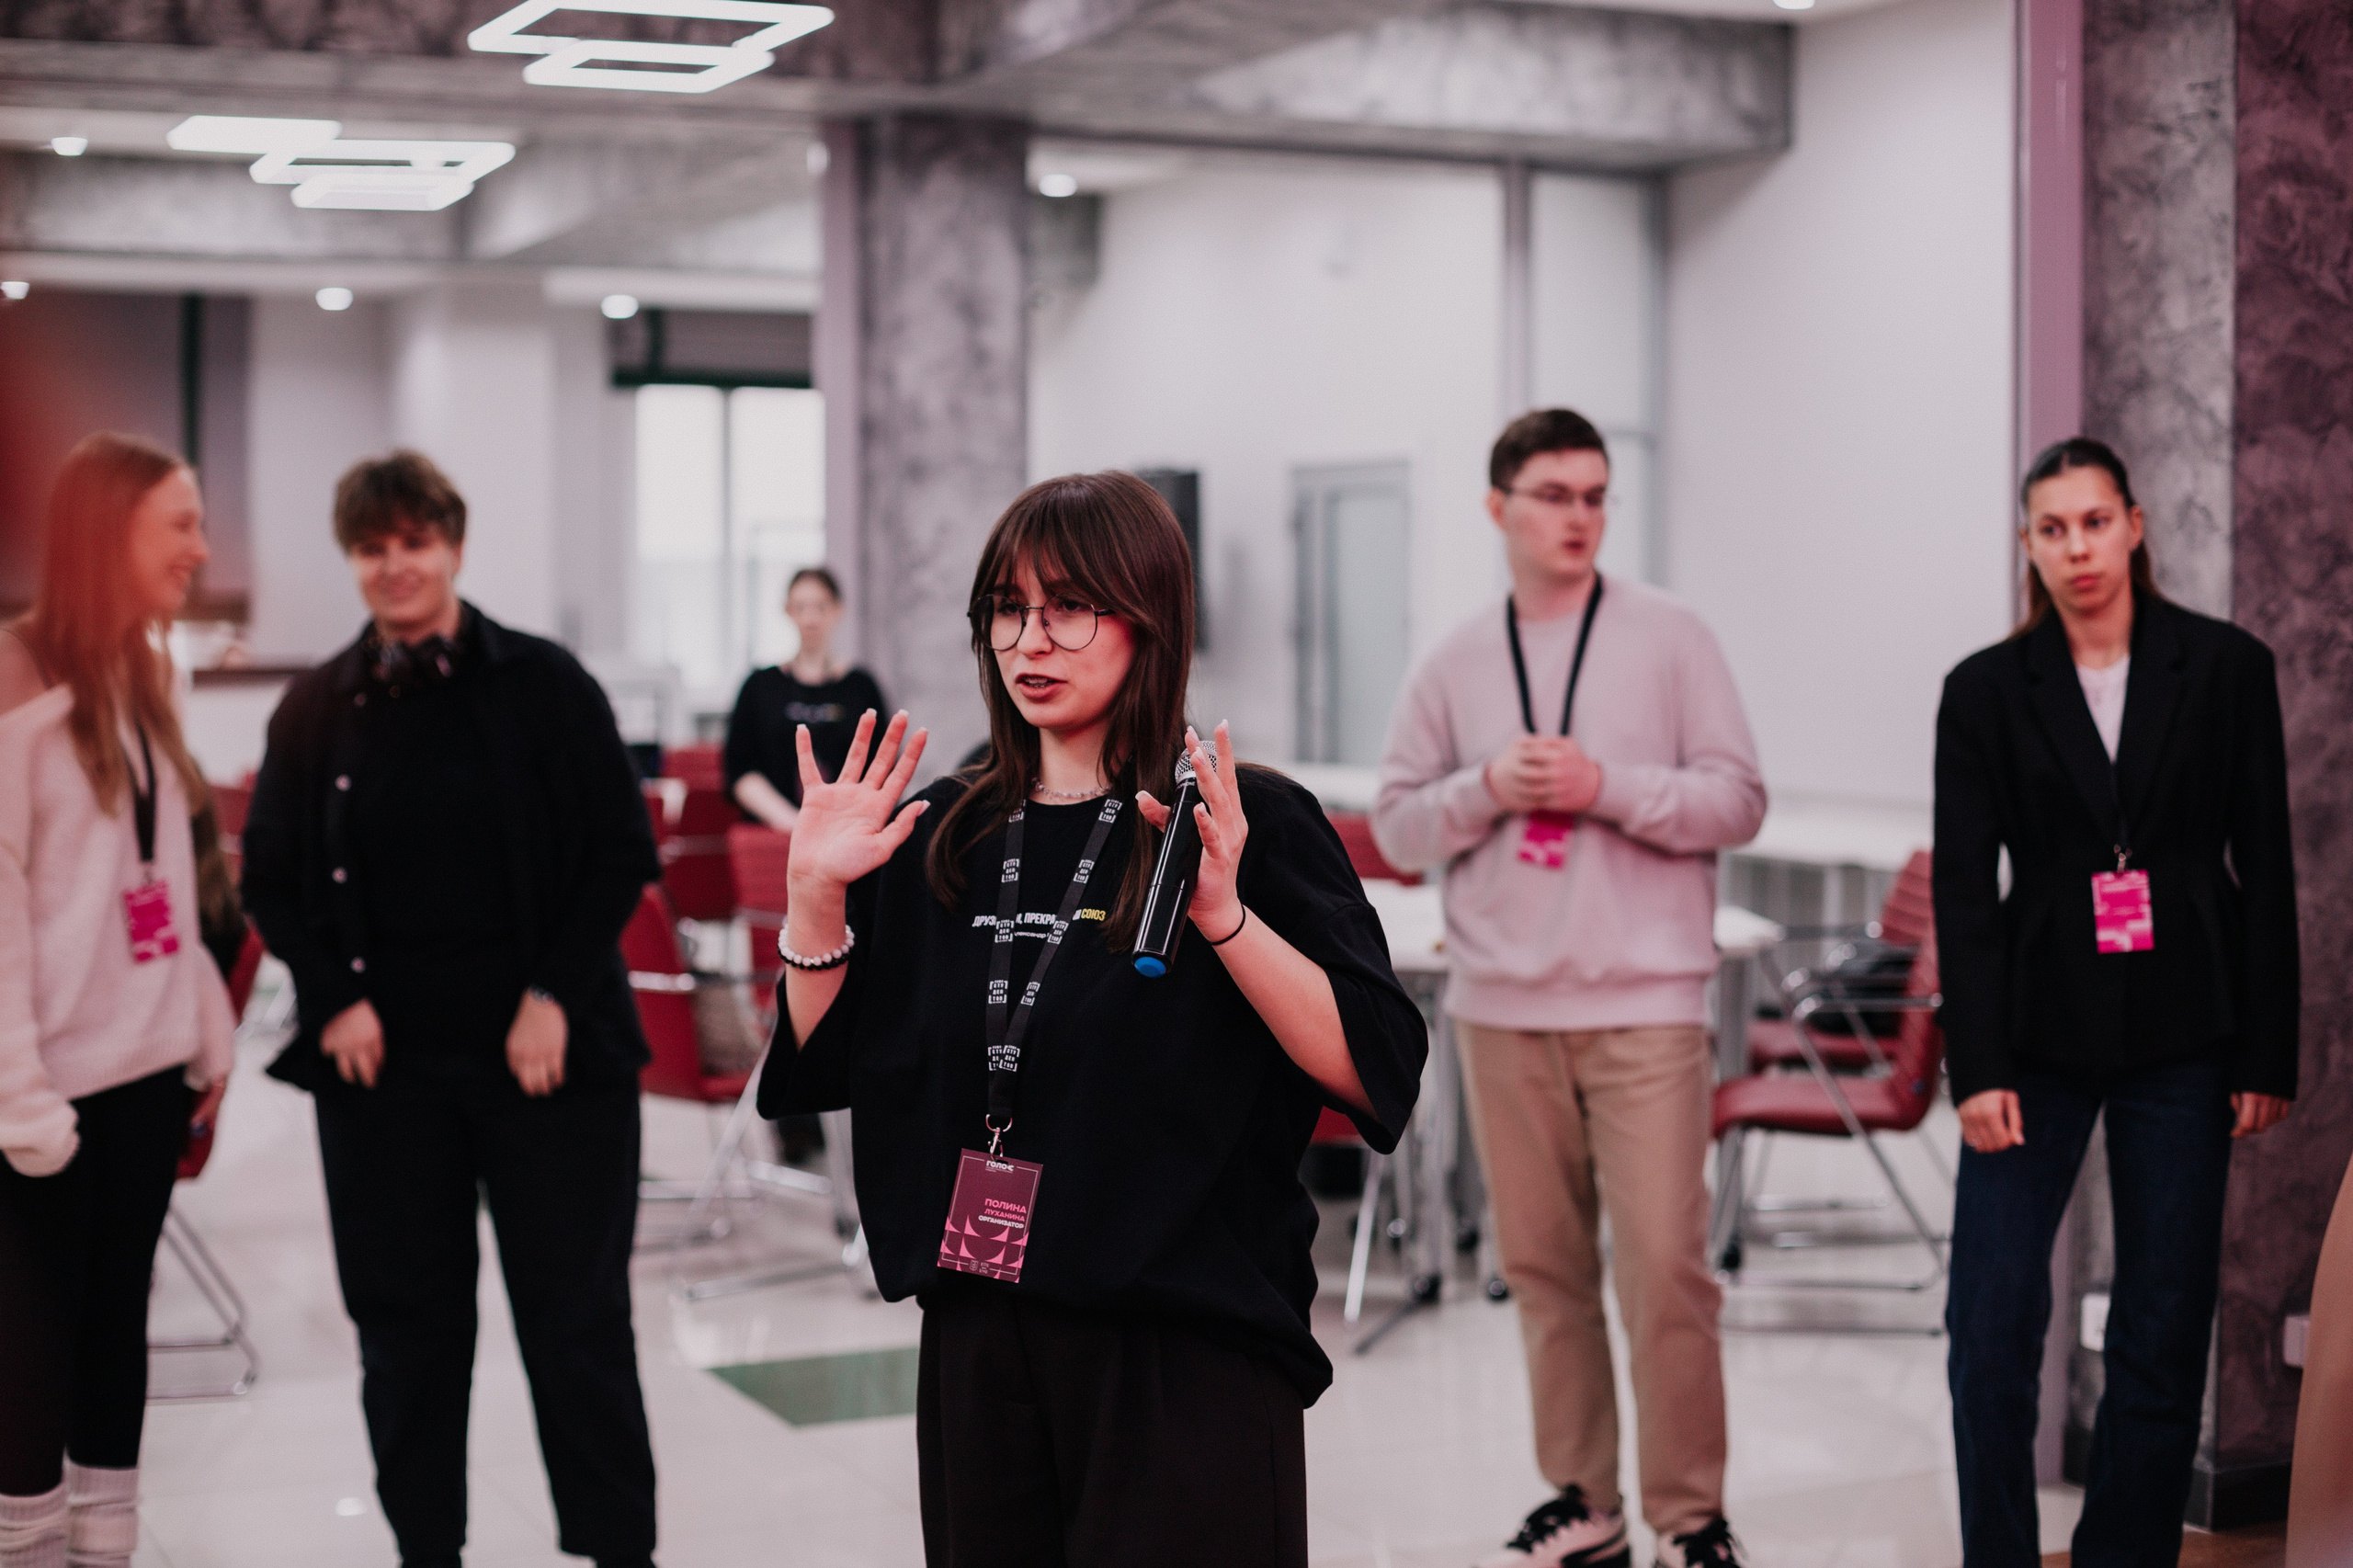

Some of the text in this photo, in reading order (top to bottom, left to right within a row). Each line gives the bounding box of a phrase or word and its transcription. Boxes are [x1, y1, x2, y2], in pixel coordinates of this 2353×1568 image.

[972, 915, 996, 926] ДРУЗ
[1024, 912, 1056, 926] ПРЕКРА
[1082, 908, 1106, 921] СОЮЗ
[984, 1199, 1027, 1213] ПОЛИНА
[978, 1214, 1025, 1229] ОРГАНИЗАТОР
[984, 1209, 1025, 1221] ЛУХАНИНА
